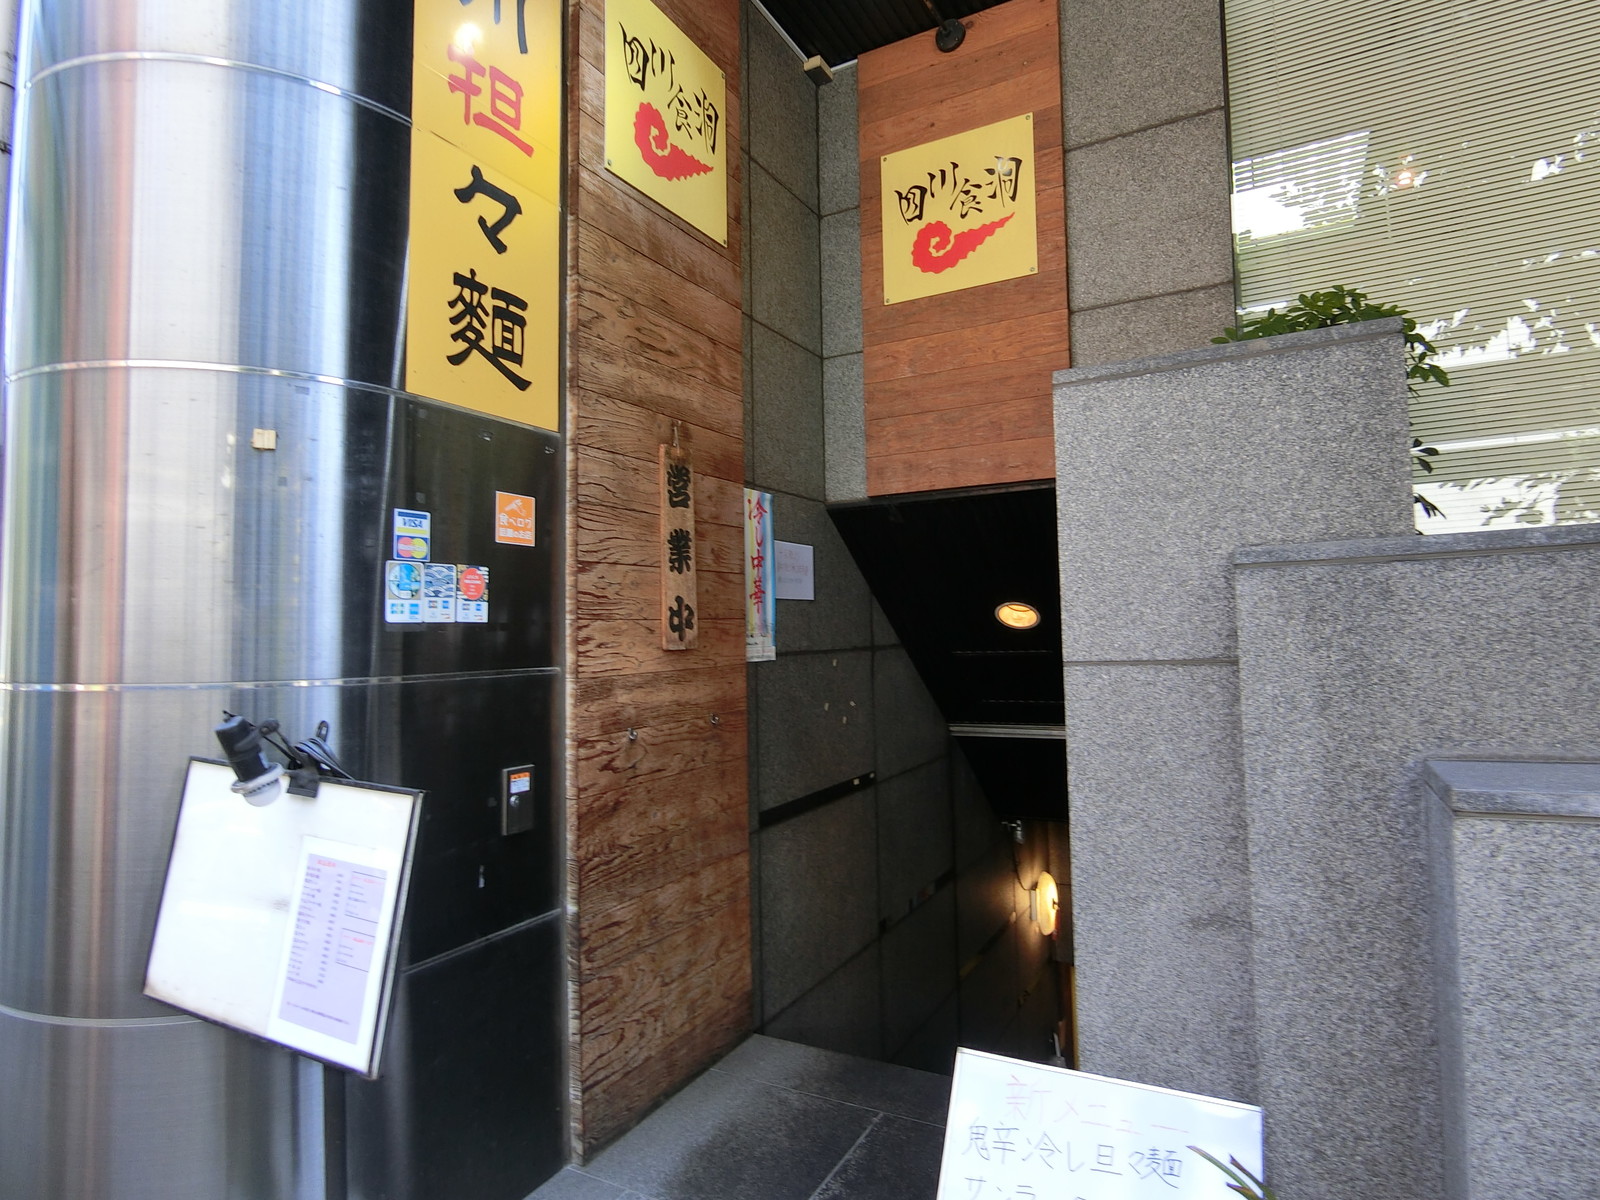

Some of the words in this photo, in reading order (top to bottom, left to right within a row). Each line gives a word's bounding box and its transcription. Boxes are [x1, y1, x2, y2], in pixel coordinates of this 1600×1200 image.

[402, 517, 424, 529] VISA
[666, 463, 695, 643] 営業中
[1006, 1073, 1190, 1135] 新メニュー
